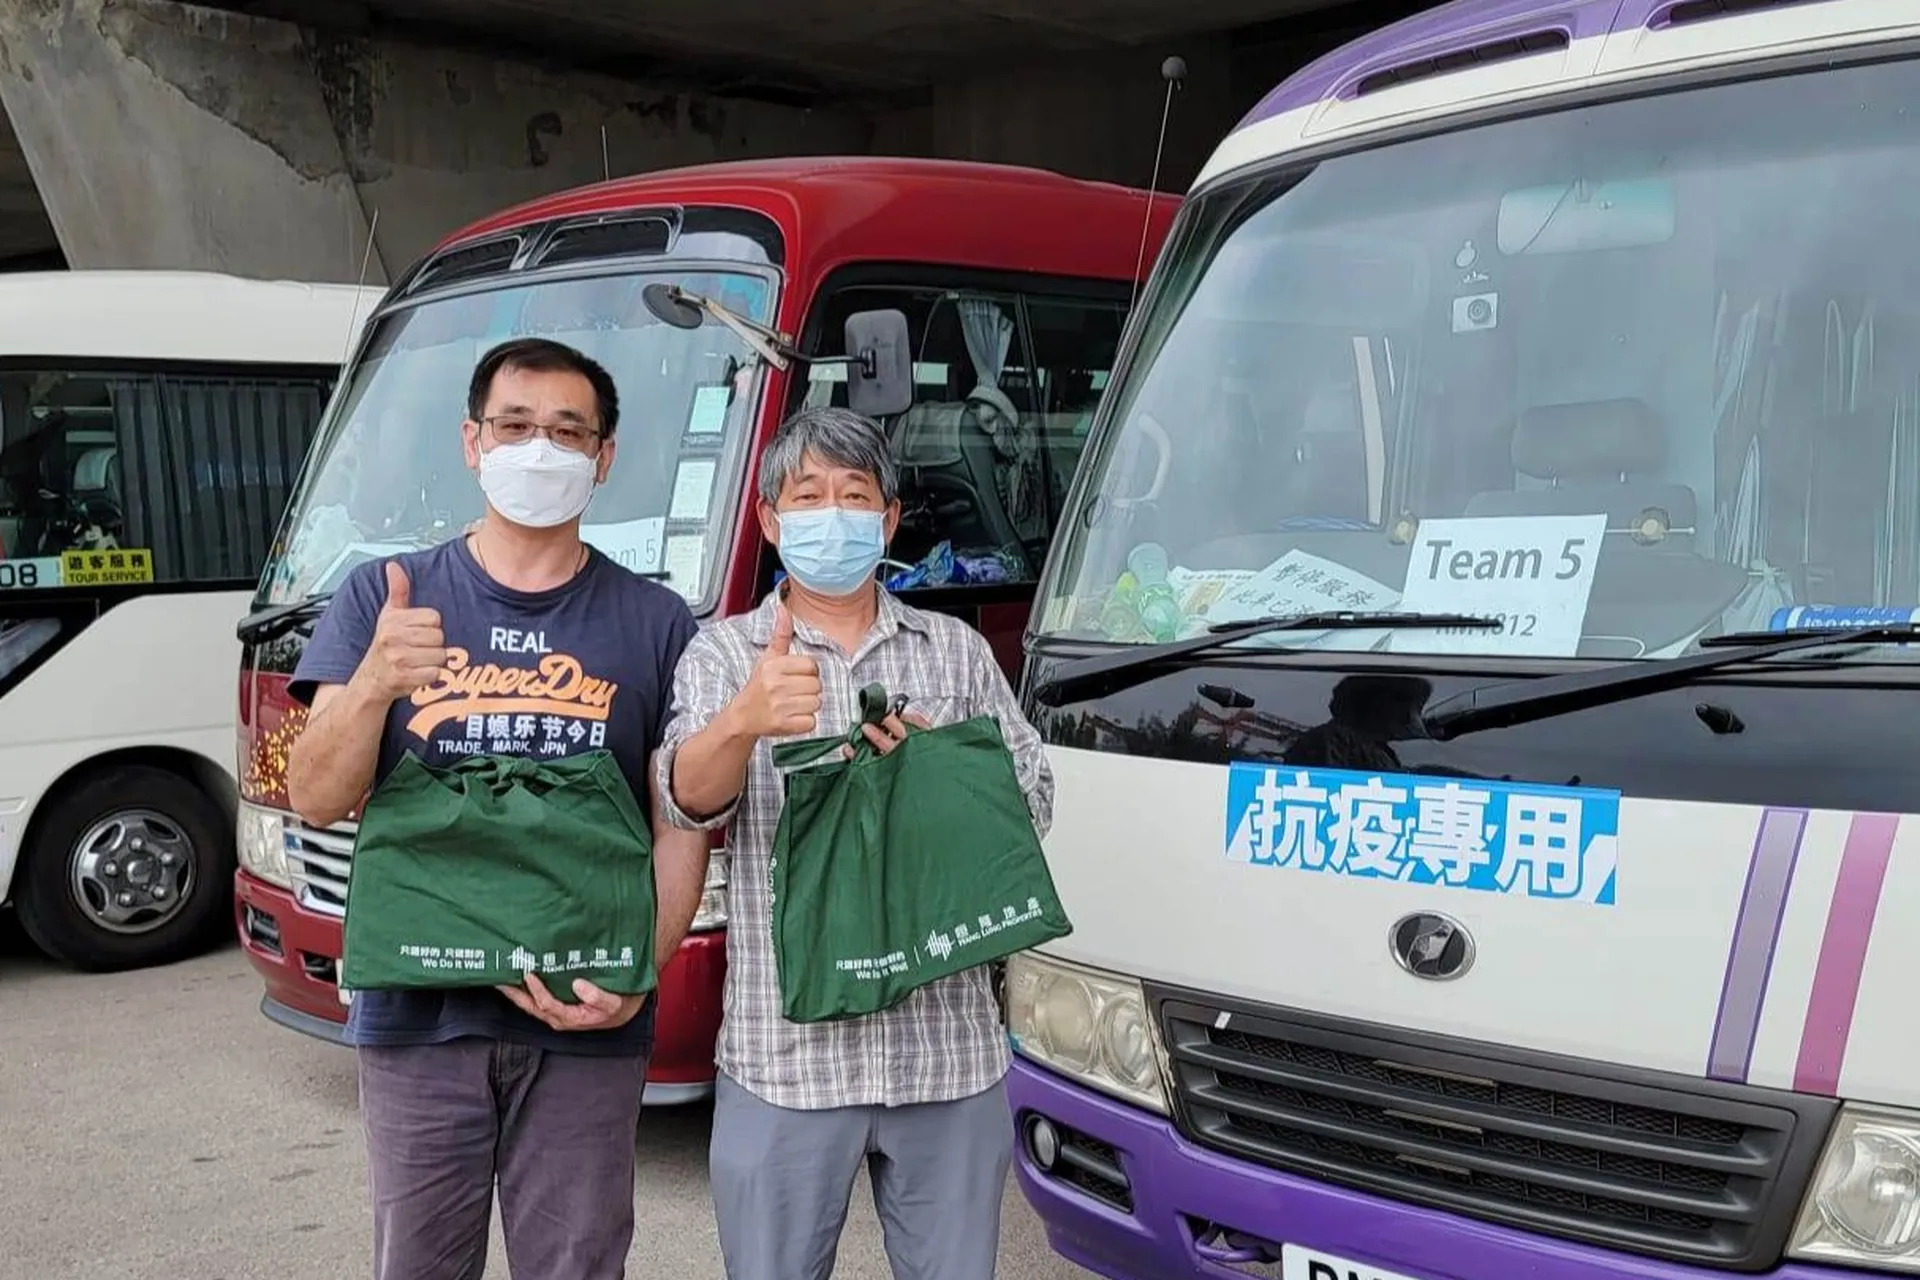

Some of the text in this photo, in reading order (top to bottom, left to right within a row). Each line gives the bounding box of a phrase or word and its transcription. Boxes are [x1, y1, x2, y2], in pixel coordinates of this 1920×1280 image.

[645, 538, 657, 565] 5
[1426, 538, 1586, 580] Team 5
[68, 569, 148, 584] TOUR SERVICE
[490, 626, 553, 653] REAL
[539, 742, 567, 756] JPN
[1248, 768, 1584, 895] 抗疫專用
[981, 922, 1002, 938] LUNG
[422, 957, 438, 968] We
[439, 958, 453, 969] Do
[464, 960, 485, 970] Well
